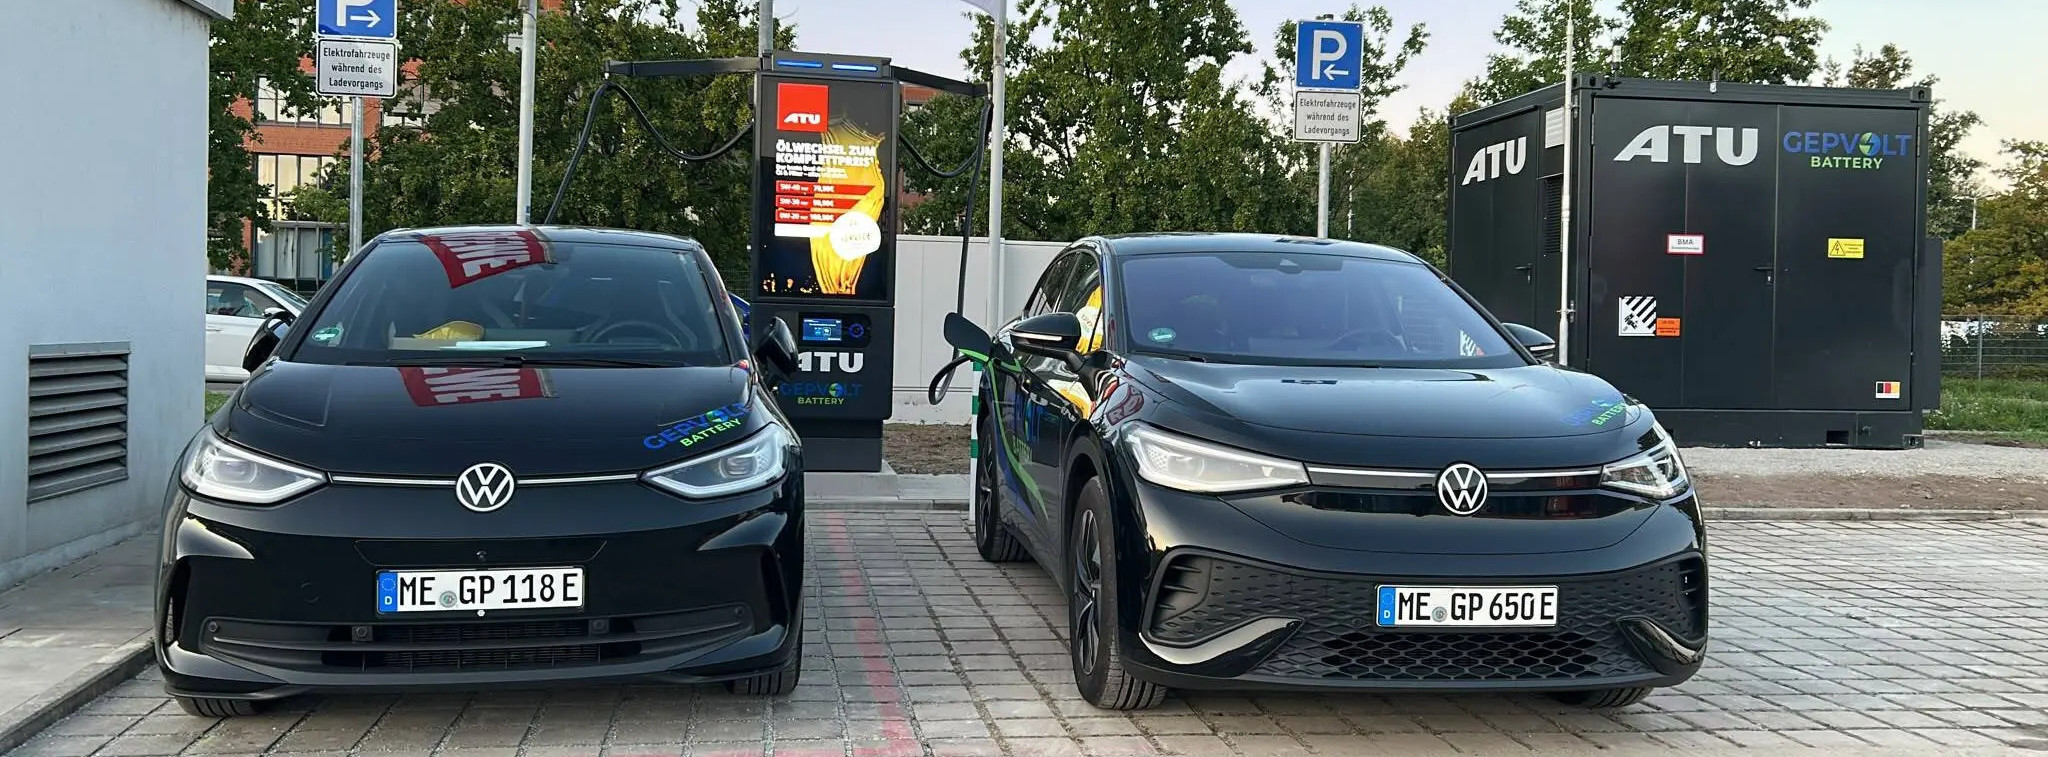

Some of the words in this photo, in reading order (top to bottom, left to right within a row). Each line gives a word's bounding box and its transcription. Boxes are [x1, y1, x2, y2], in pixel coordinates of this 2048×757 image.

[323, 47, 391, 61] Elektrofahrzeuge
[1312, 30, 1347, 80] P
[331, 62, 365, 74] während
[368, 64, 383, 74] des
[328, 77, 384, 91] Ladevorgangs
[1300, 98, 1357, 110] Elektrofahrzeuge
[783, 113, 821, 124] ATU
[1306, 112, 1335, 121] während
[1337, 113, 1350, 122] des
[1304, 125, 1350, 136] Ladevorgangs
[776, 139, 847, 156] ÖLWECHSEL
[848, 144, 877, 157] ZUM
[1612, 125, 1759, 166] ATU
[1783, 131, 1912, 157] GEPVOLT
[1461, 136, 1527, 186] ATU
[1810, 156, 1883, 169] BATTERY
[797, 397, 845, 405] BATTERY
[680, 418, 742, 447] BATTERY
[399, 576, 436, 606] ME
[459, 575, 495, 605] GP
[502, 573, 555, 604] 118
[563, 573, 579, 601] E
[384, 595, 393, 606] D
[1398, 592, 1431, 621] ME
[1451, 592, 1484, 621] GP
[1489, 592, 1535, 621] 650
[1540, 592, 1555, 621] E
[1383, 610, 1391, 619] D
